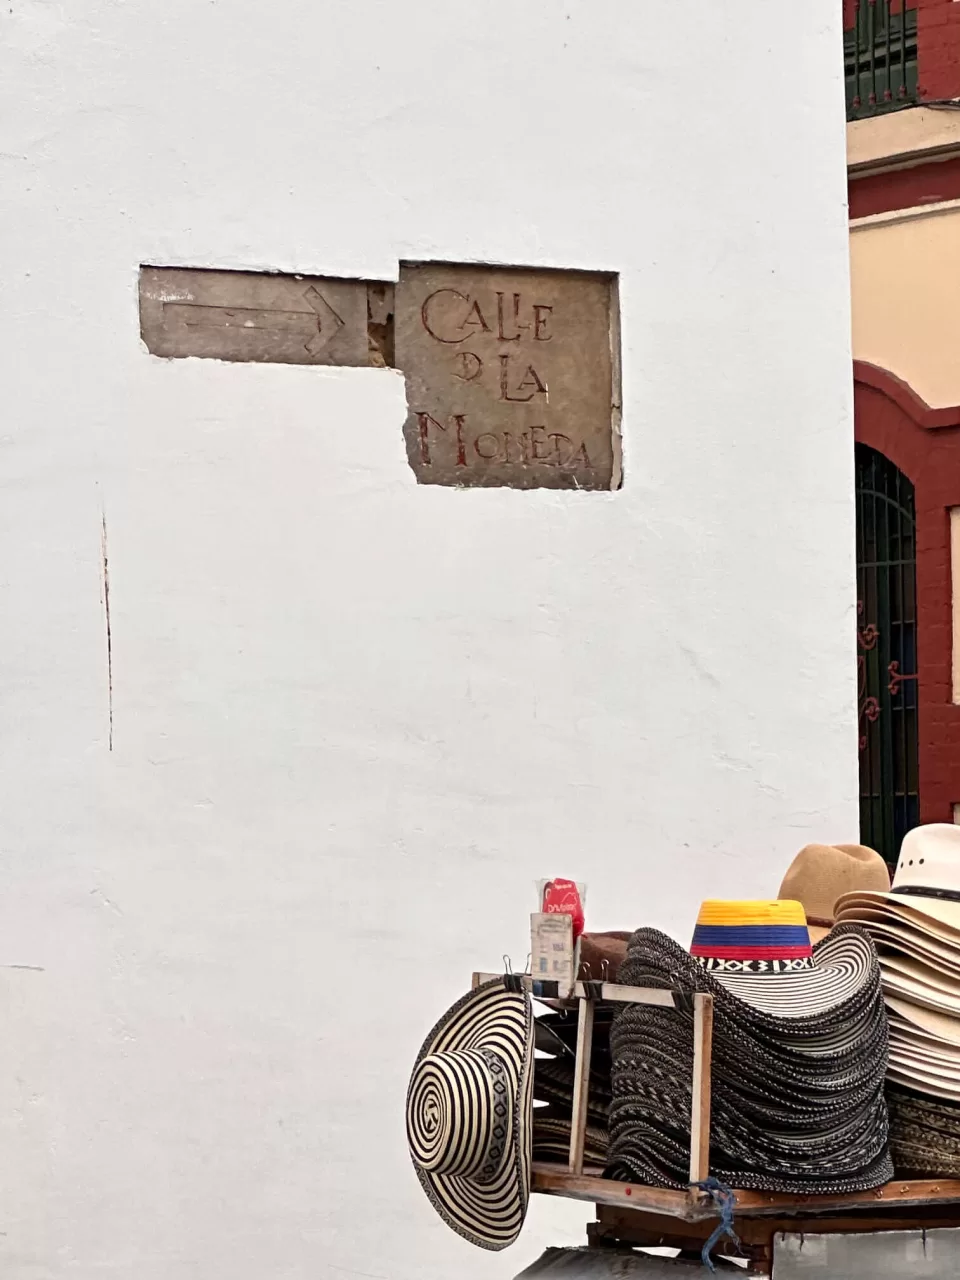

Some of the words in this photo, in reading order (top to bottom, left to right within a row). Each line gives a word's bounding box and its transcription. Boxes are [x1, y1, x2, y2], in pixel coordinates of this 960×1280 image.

[421, 288, 553, 344] CALLE
[498, 354, 549, 402] LA
[414, 411, 596, 470] MONEDA
